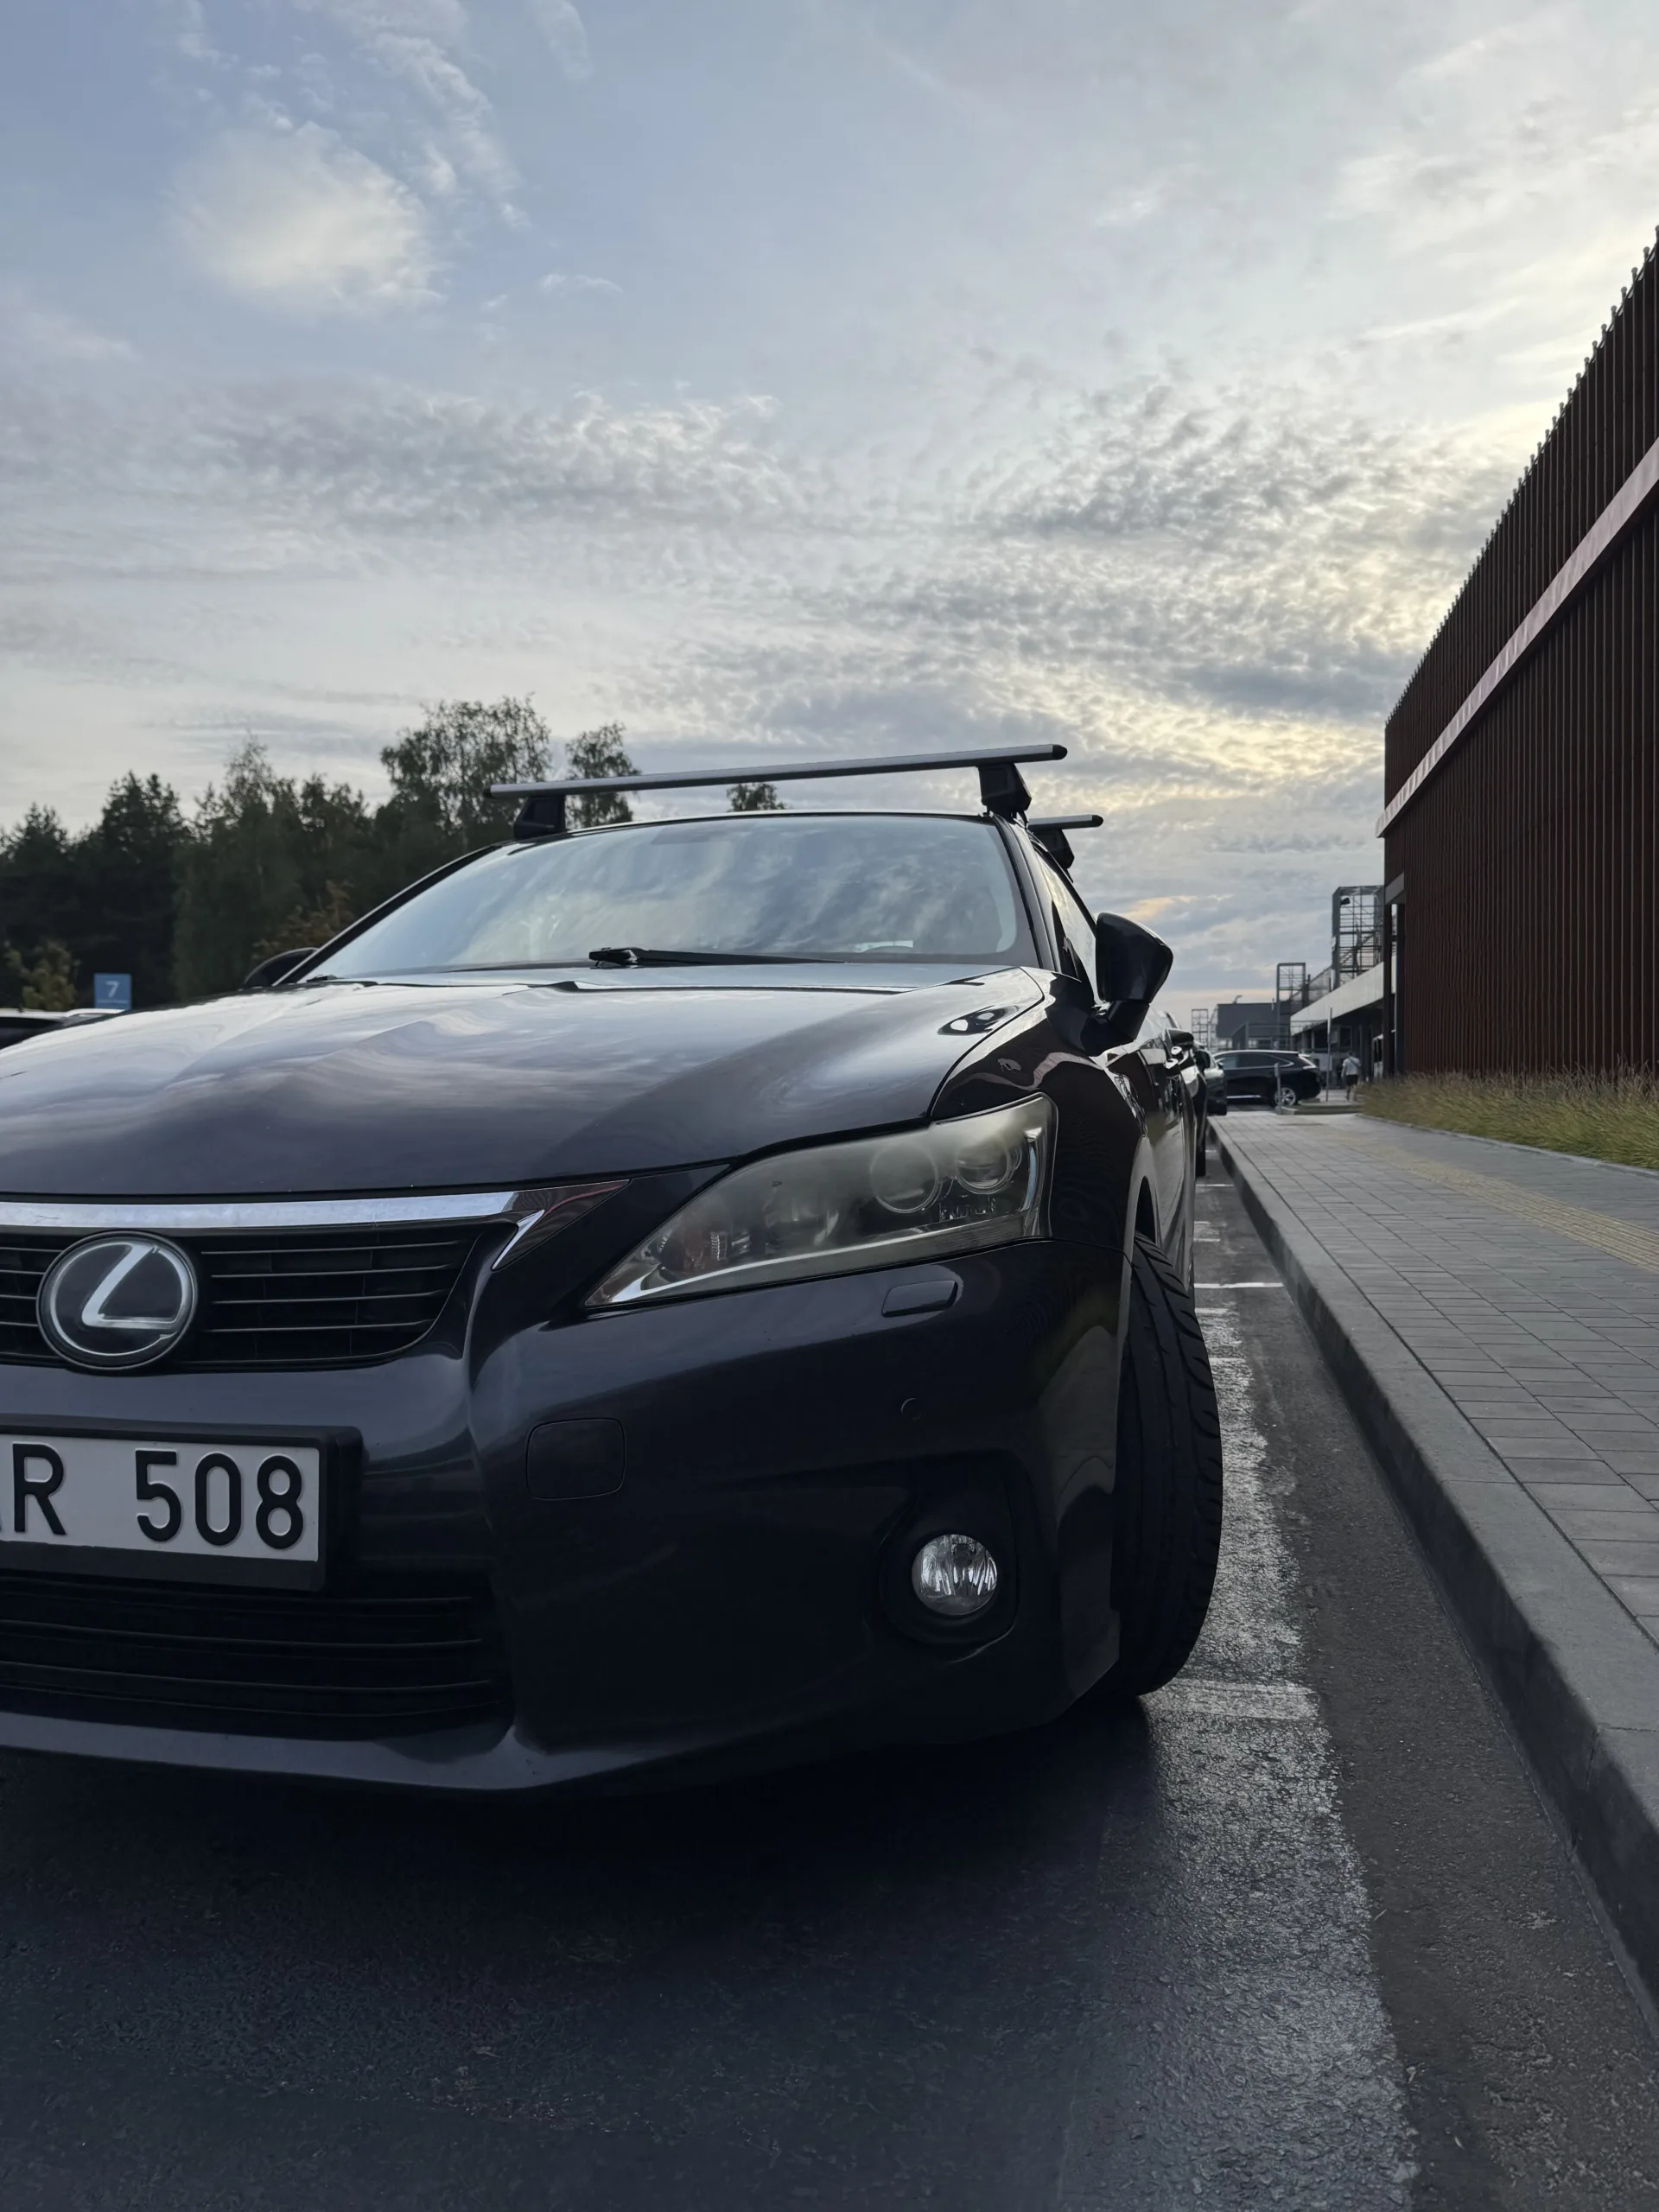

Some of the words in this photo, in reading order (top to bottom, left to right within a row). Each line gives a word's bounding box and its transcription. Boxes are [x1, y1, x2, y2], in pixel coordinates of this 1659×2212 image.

[105, 981, 120, 998] 7
[0, 1441, 67, 1535] R
[136, 1449, 304, 1549] 508
